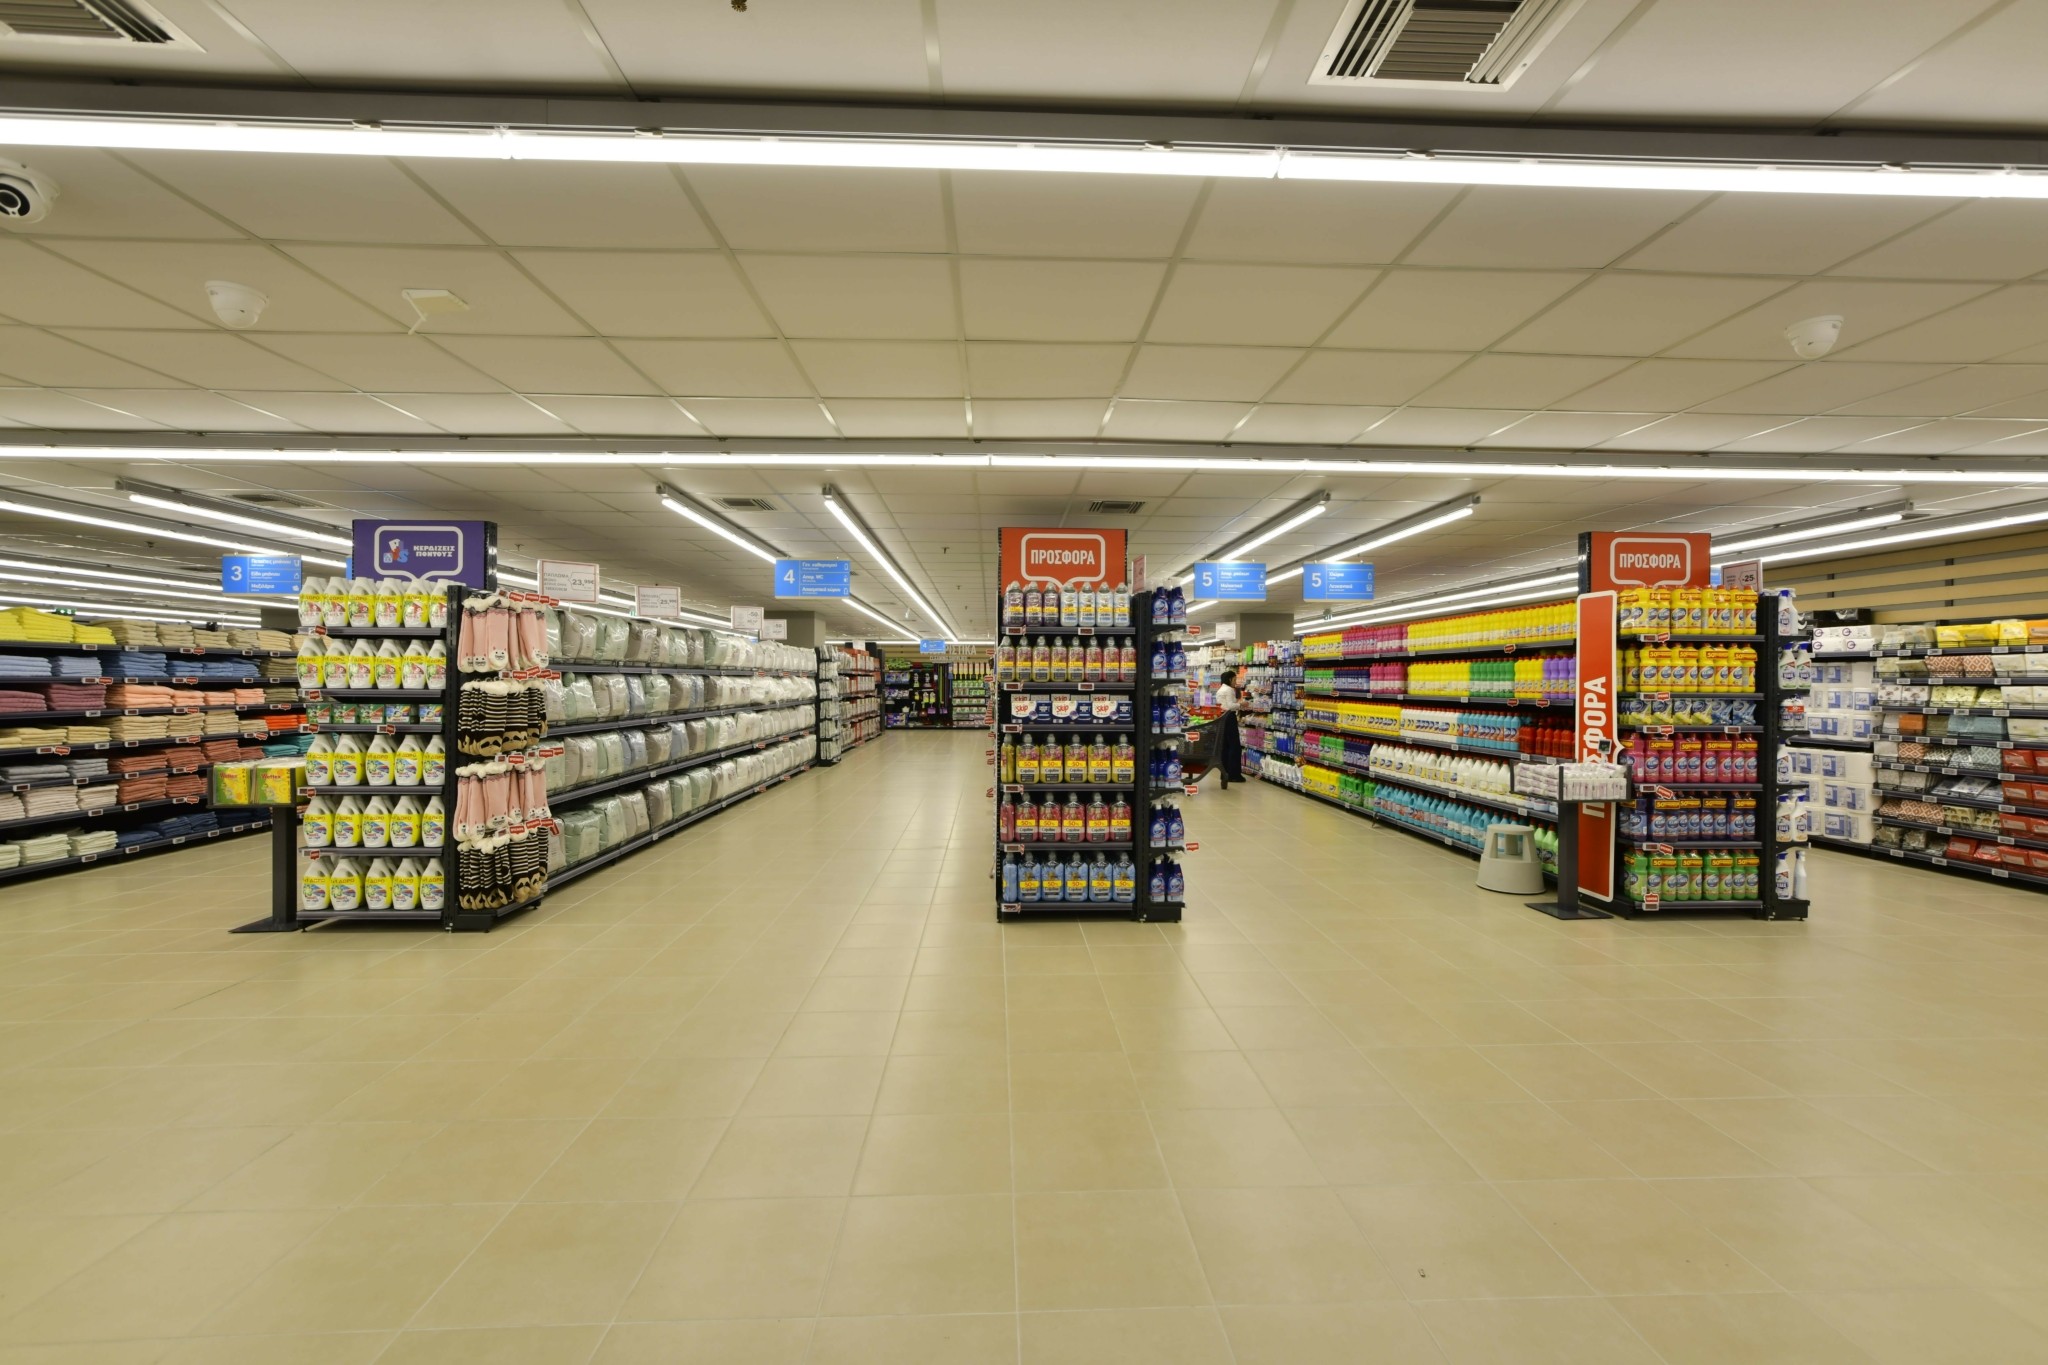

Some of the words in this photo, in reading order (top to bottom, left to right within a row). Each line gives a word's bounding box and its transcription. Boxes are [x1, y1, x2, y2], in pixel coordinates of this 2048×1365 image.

[1030, 549, 1095, 565] ΠΡΟΣΦΟΡΑ
[1619, 553, 1681, 569] ΠΡΟΣΦΟΡΑ
[231, 565, 242, 581] 3
[783, 569, 795, 584] 4
[1202, 571, 1213, 587] 5
[1311, 572, 1322, 588] 5
